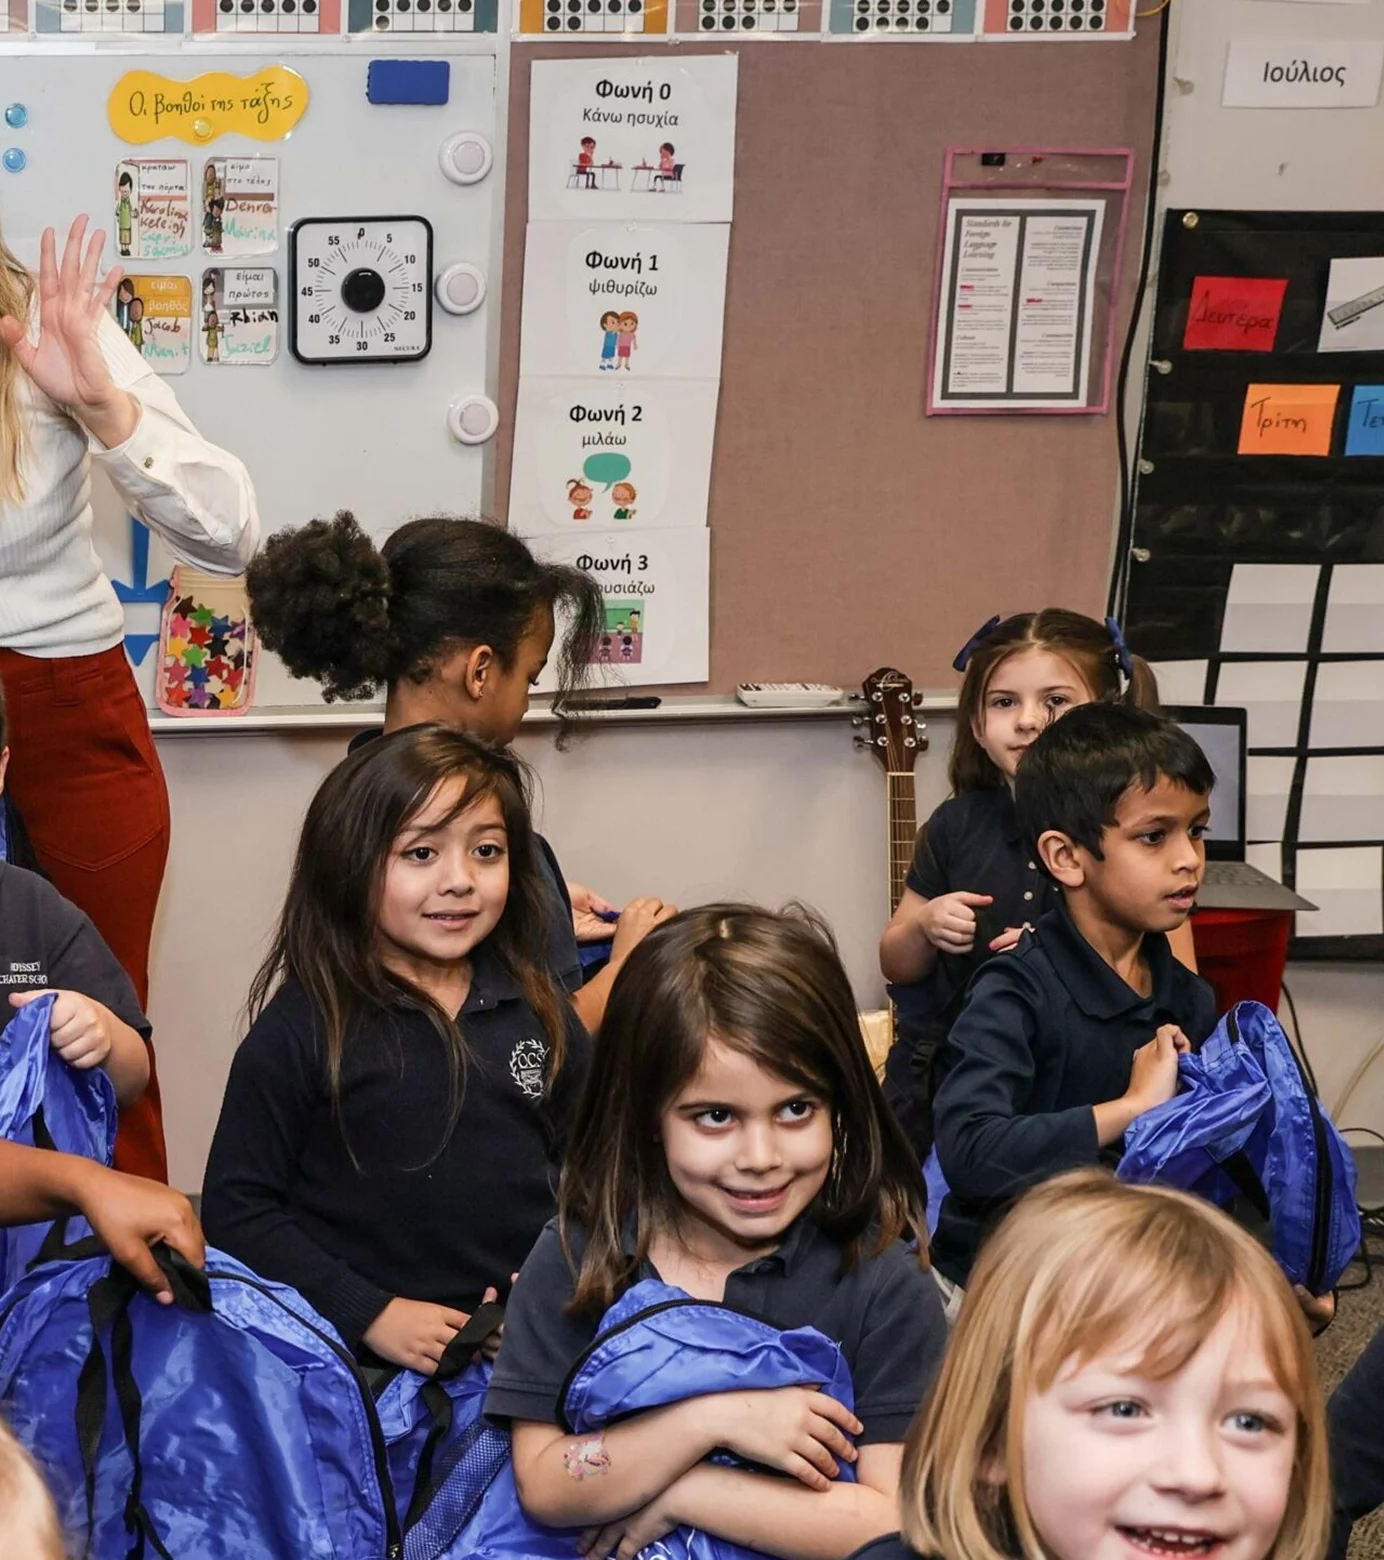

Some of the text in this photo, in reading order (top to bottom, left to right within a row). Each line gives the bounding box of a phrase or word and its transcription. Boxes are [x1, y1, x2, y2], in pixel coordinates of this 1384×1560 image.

[1263, 60, 1346, 87] Ιούλιος
[596, 79, 672, 103] Φωνή 0
[583, 107, 679, 128] Κάνω ησυχία
[328, 236, 340, 245] 55
[386, 234, 393, 243] 5
[308, 258, 320, 268] 50
[405, 255, 416, 264] 10
[585, 250, 659, 273] Φωνή 1
[301, 287, 313, 296] 45
[412, 283, 423, 292] 15
[589, 279, 658, 297] ψιθυρίζω
[308, 314, 320, 324] 40
[404, 311, 416, 320] 20
[328, 335, 340, 344] 35
[384, 333, 396, 342] 25
[356, 341, 368, 351] 30
[569, 405, 643, 425] Φωνή 2
[582, 431, 627, 449] μιλάω
[576, 553, 649, 574] Φωνή 3
[597, 579, 655, 596] ουσιάζω
